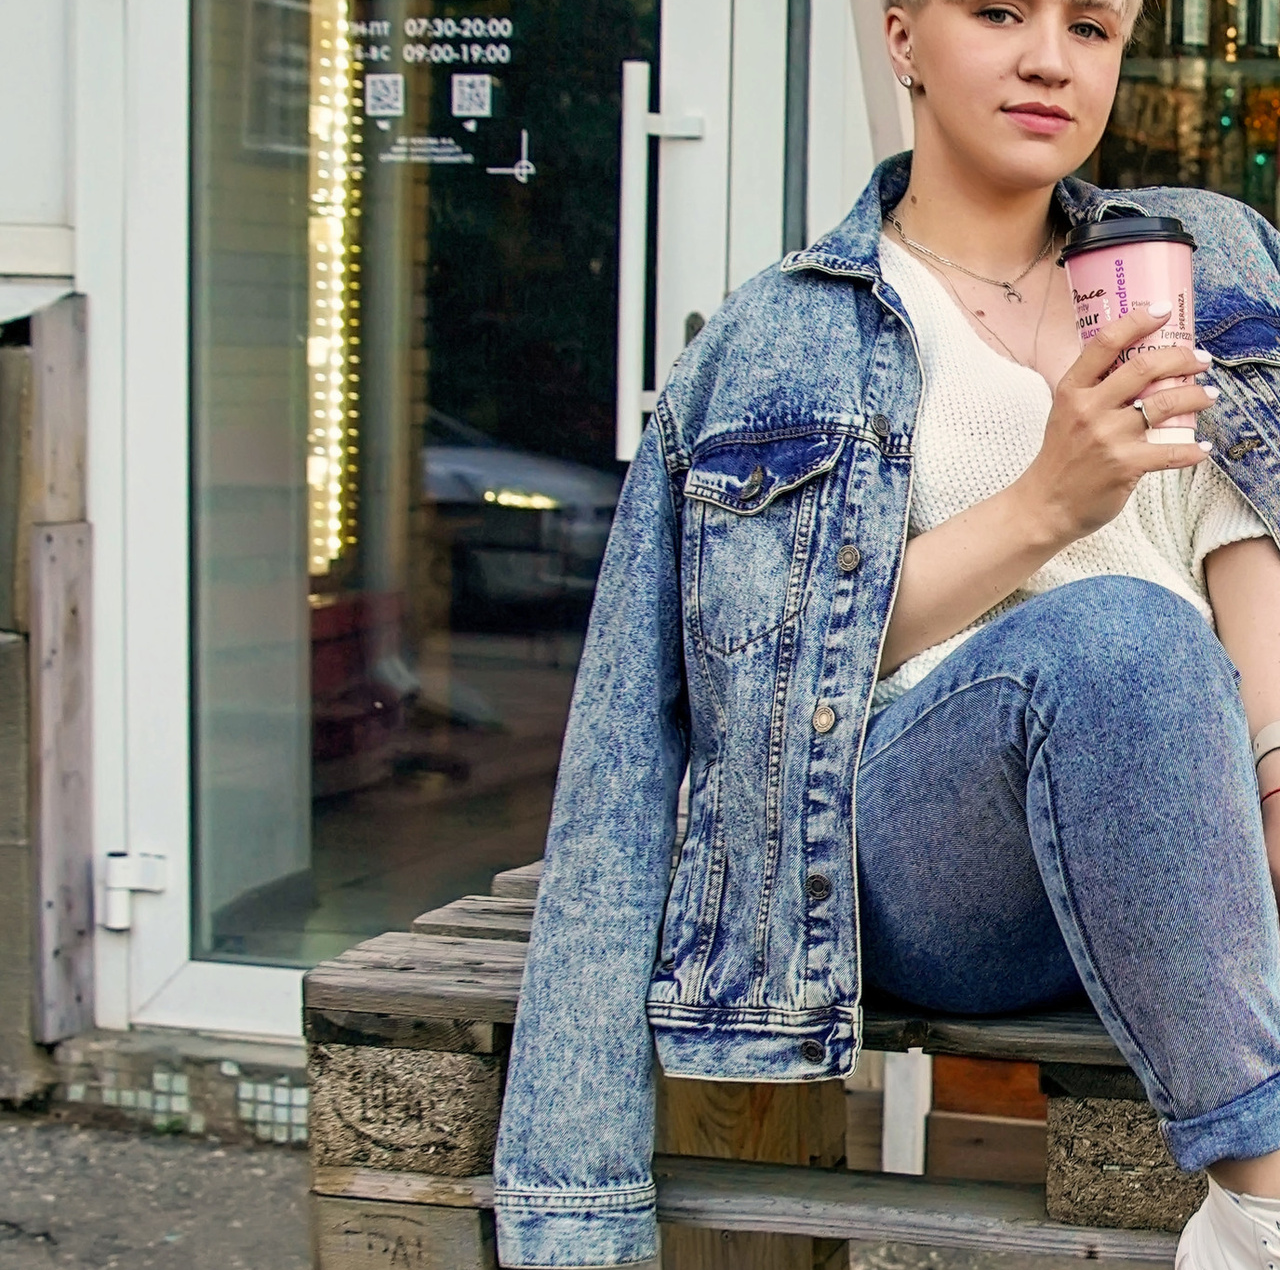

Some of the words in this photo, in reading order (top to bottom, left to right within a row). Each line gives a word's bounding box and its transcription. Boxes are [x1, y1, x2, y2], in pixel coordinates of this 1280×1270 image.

[405, 18, 513, 38] 07:30-20:00
[403, 43, 512, 63] 09:00-19:00
[1072, 289, 1107, 305] Peace
[1115, 259, 1128, 319] endresse
[1178, 293, 1186, 330] SPERANZA
